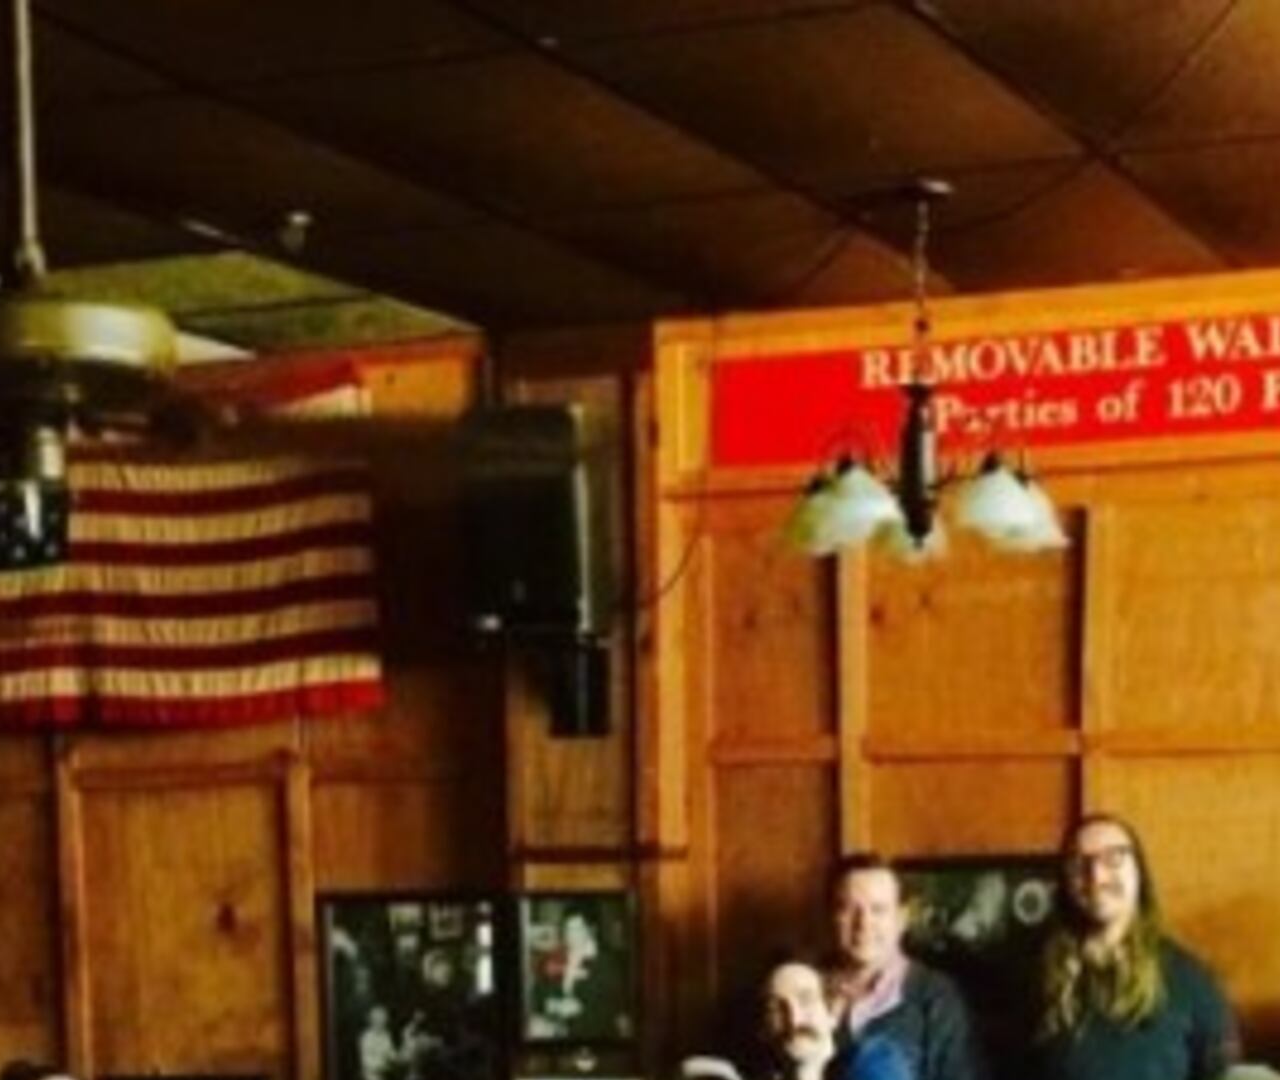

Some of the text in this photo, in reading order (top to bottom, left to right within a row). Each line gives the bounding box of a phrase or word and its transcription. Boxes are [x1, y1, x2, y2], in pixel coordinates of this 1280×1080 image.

[860, 326, 1166, 390] REMOVABLE
[933, 387, 1078, 435] Parties
[1095, 378, 1145, 424] of
[1170, 373, 1243, 419] 120
